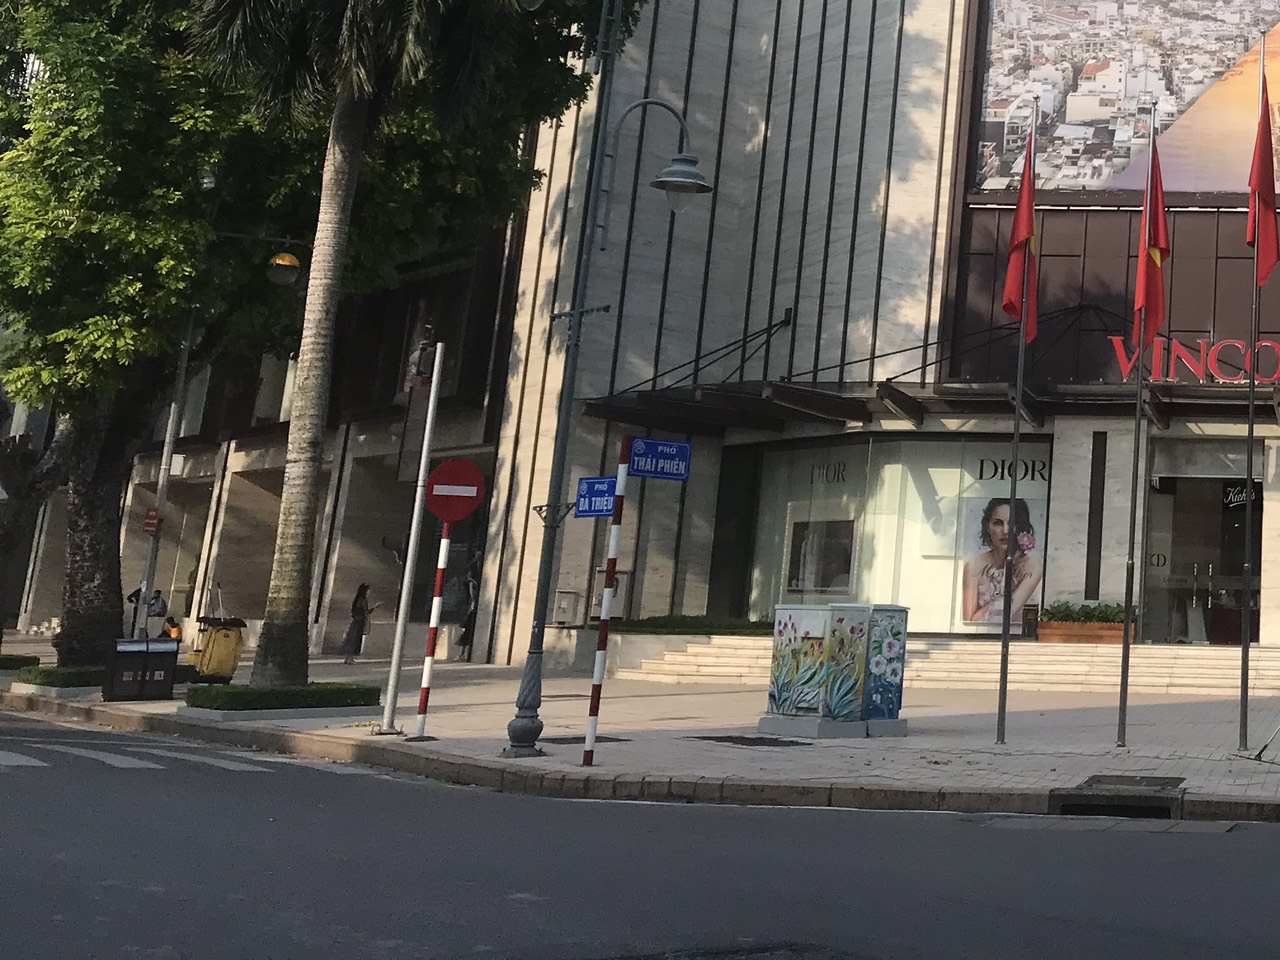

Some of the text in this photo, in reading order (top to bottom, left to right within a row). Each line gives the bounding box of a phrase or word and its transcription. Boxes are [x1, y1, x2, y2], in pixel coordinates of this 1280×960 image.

[633, 454, 686, 474] THÁI PHIÊN
[809, 462, 847, 485] DIOR
[978, 458, 1049, 482] DIOR
[1224, 486, 1256, 506] Kieh's
